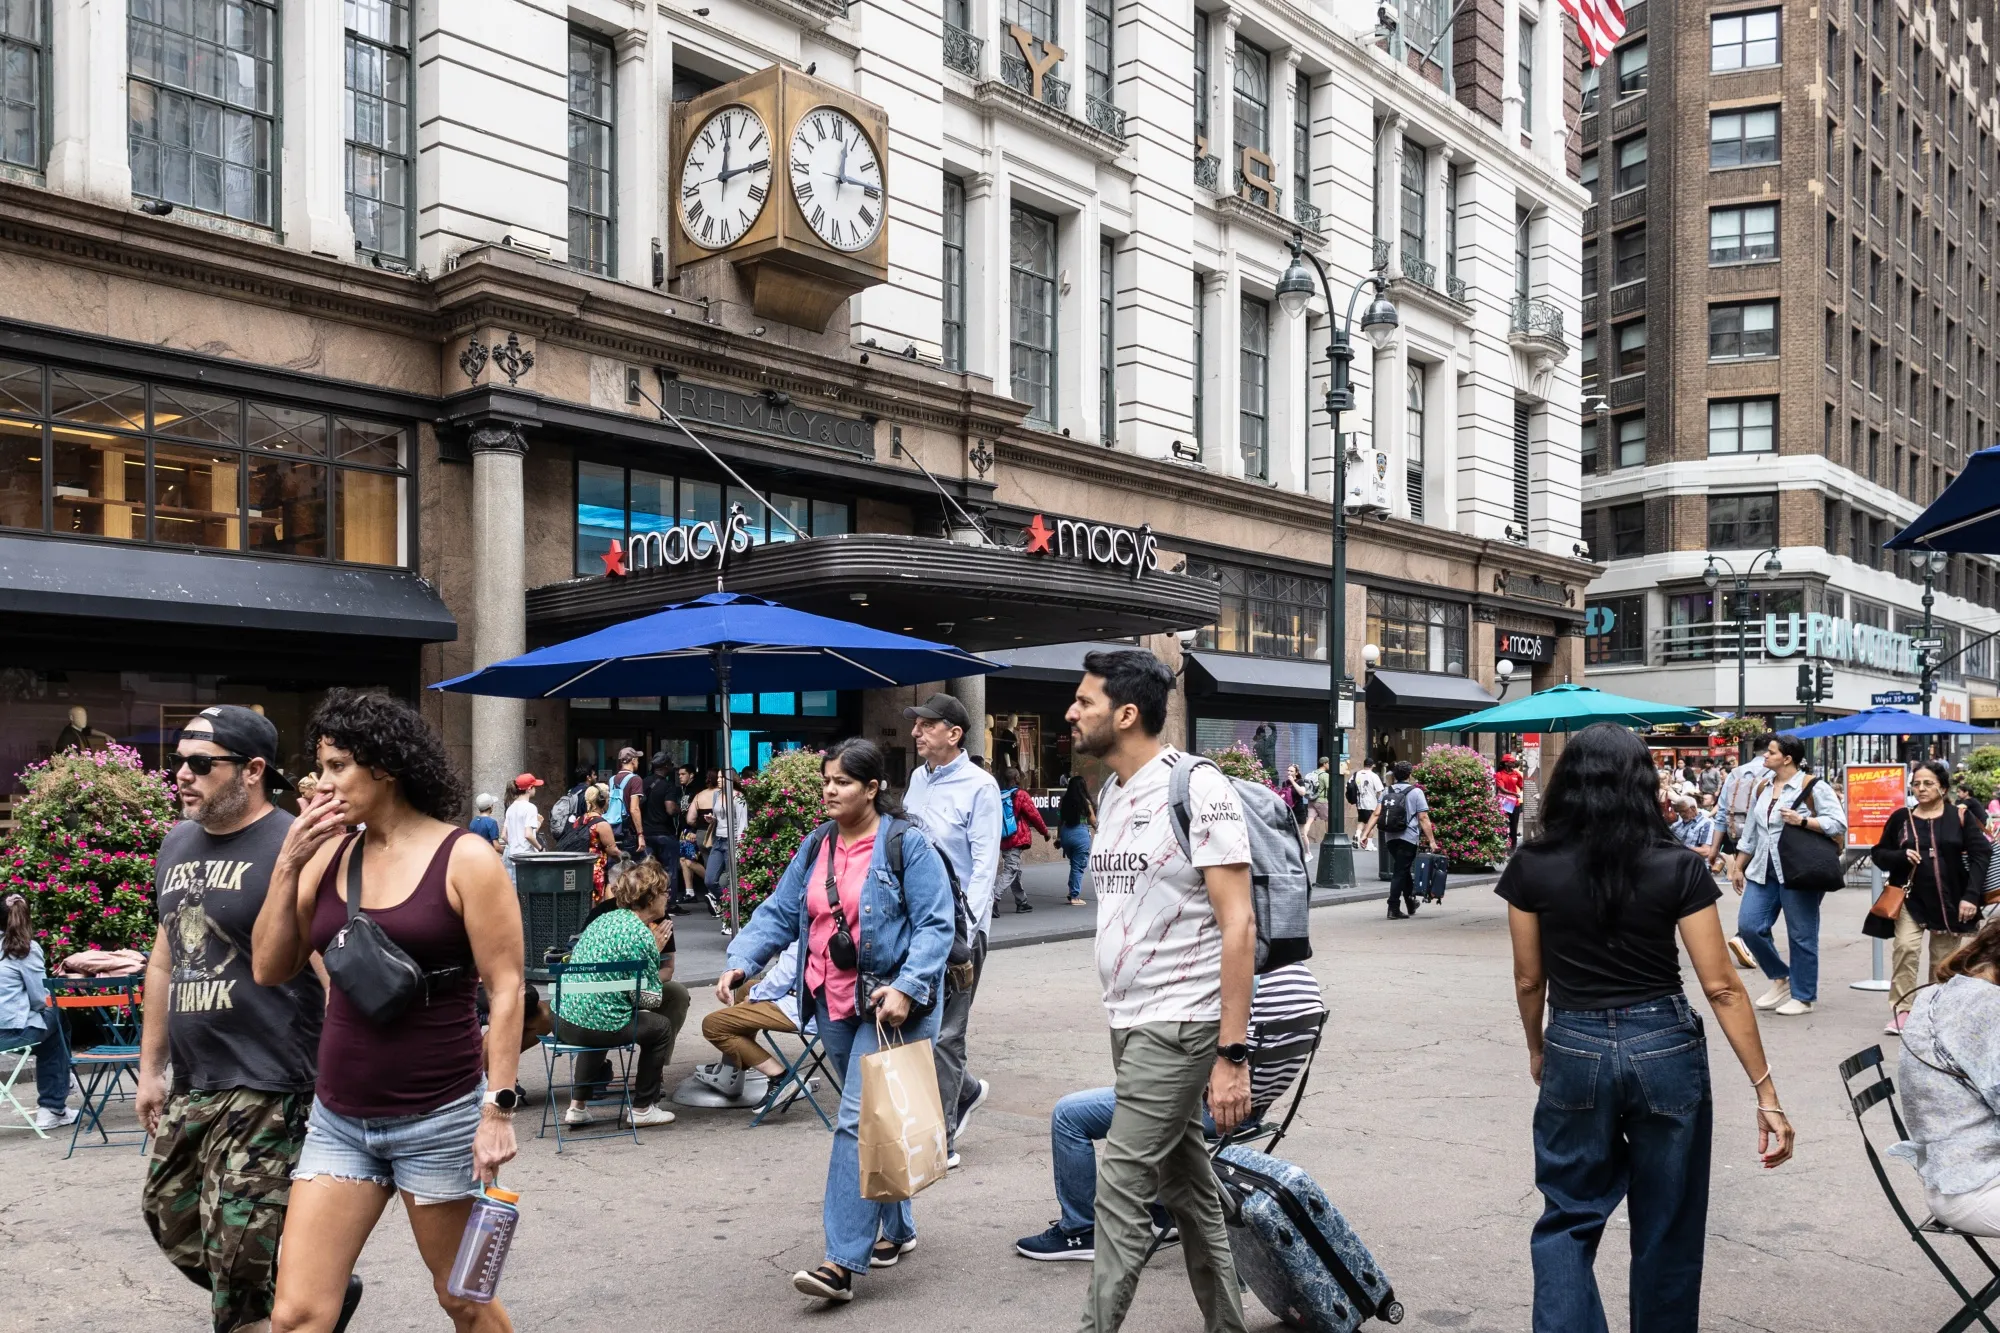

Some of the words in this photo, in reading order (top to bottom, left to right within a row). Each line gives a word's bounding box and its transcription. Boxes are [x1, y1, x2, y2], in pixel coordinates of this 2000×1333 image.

[628, 501, 752, 572] macy's
[1056, 519, 1159, 580] macy's
[1509, 635, 1542, 660] macy's
[1765, 611, 1853, 661] URBAN
[1906, 695, 1914, 703] St
[1848, 770, 1885, 782] SWEAT
[1887, 767, 1903, 778] 34
[1051, 795, 1061, 808] OF
[1209, 802, 1233, 811] VISIT
[1200, 811, 1244, 824] RWANDA
[1090, 848, 1149, 873] mirates
[161, 860, 201, 896] LESS
[204, 860, 254, 891] TALK
[1106, 875, 1136, 895] BETTER
[175, 979, 237, 1013] HAWK
